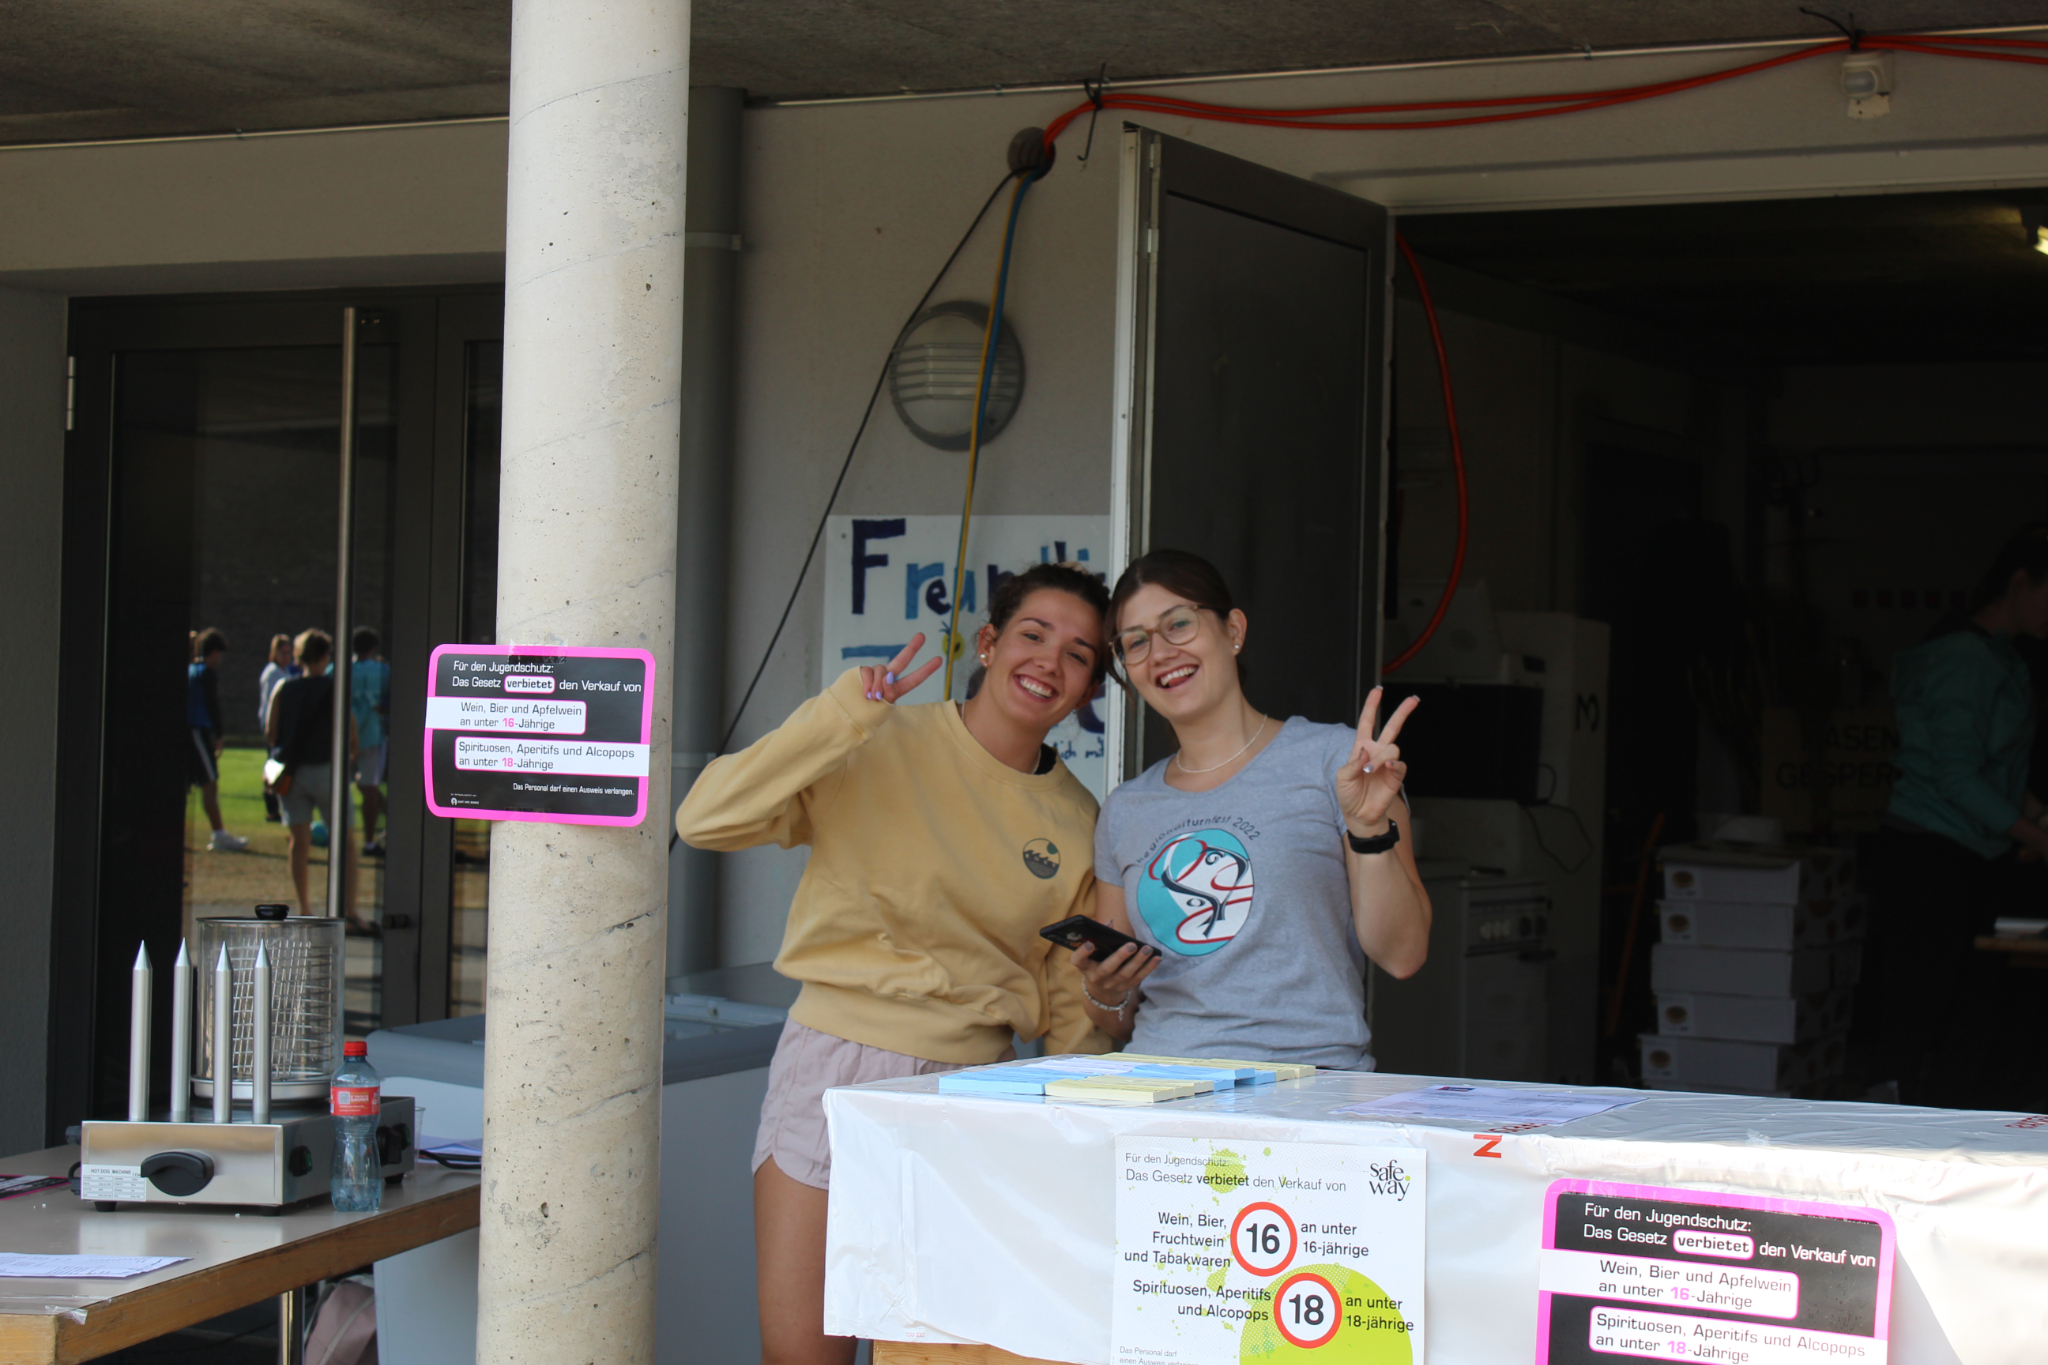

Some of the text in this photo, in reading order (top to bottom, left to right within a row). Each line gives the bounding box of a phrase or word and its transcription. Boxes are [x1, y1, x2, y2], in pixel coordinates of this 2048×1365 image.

[454, 661, 554, 674] Für den Jugendschutz:
[453, 677, 641, 692] Das Gesetz verbietet den Verkauf von
[461, 702, 582, 718] Wein, Bier und Apfelwein
[460, 718, 555, 730] an unter 16-Jährige
[1803, 723, 1898, 751] ASEN
[459, 742, 634, 760] Spirituosen, Aperitifs und Alcopops
[473, 758, 498, 766] unter
[502, 758, 554, 770] 18-Jährige
[605, 787, 634, 796] verlangen.
[1233, 817, 1260, 840] 2022
[1125, 1153, 1230, 1168] Für den Jugendschutz:
[1126, 1169, 1346, 1192] Das Gesetz verbietet den Verkauf von
[1369, 1180, 1411, 1202] way
[1158, 1212, 1227, 1229] Wein, Bier,
[1585, 1203, 1752, 1232] Für den Jugendschutz:
[1301, 1222, 1357, 1236] an unter
[1153, 1231, 1224, 1247] Fruchtwein
[1246, 1223, 1280, 1254] 16
[1584, 1224, 1876, 1267] Das Gesetz verbietet den Verkauf von
[1303, 1241, 1369, 1258] 16-jährige
[1124, 1250, 1230, 1268] und Tabakwaren
[1600, 1259, 1792, 1292] Wein, Bier und Apfelwein
[1133, 1280, 1271, 1302] Spirituosen, Aperitifs
[1599, 1282, 1752, 1309] an unter 16-Jährige
[1289, 1294, 1324, 1325] 18
[1346, 1296, 1402, 1310] an unter
[1178, 1303, 1269, 1322] und Alcopops
[1346, 1315, 1414, 1333] 18-jährige
[1597, 1313, 1865, 1358] Spirituosen, Aperitifs und Alcopops
[1135, 1347, 1162, 1356] Personal
[1596, 1335, 1749, 1363] an unter 18-Jährige
